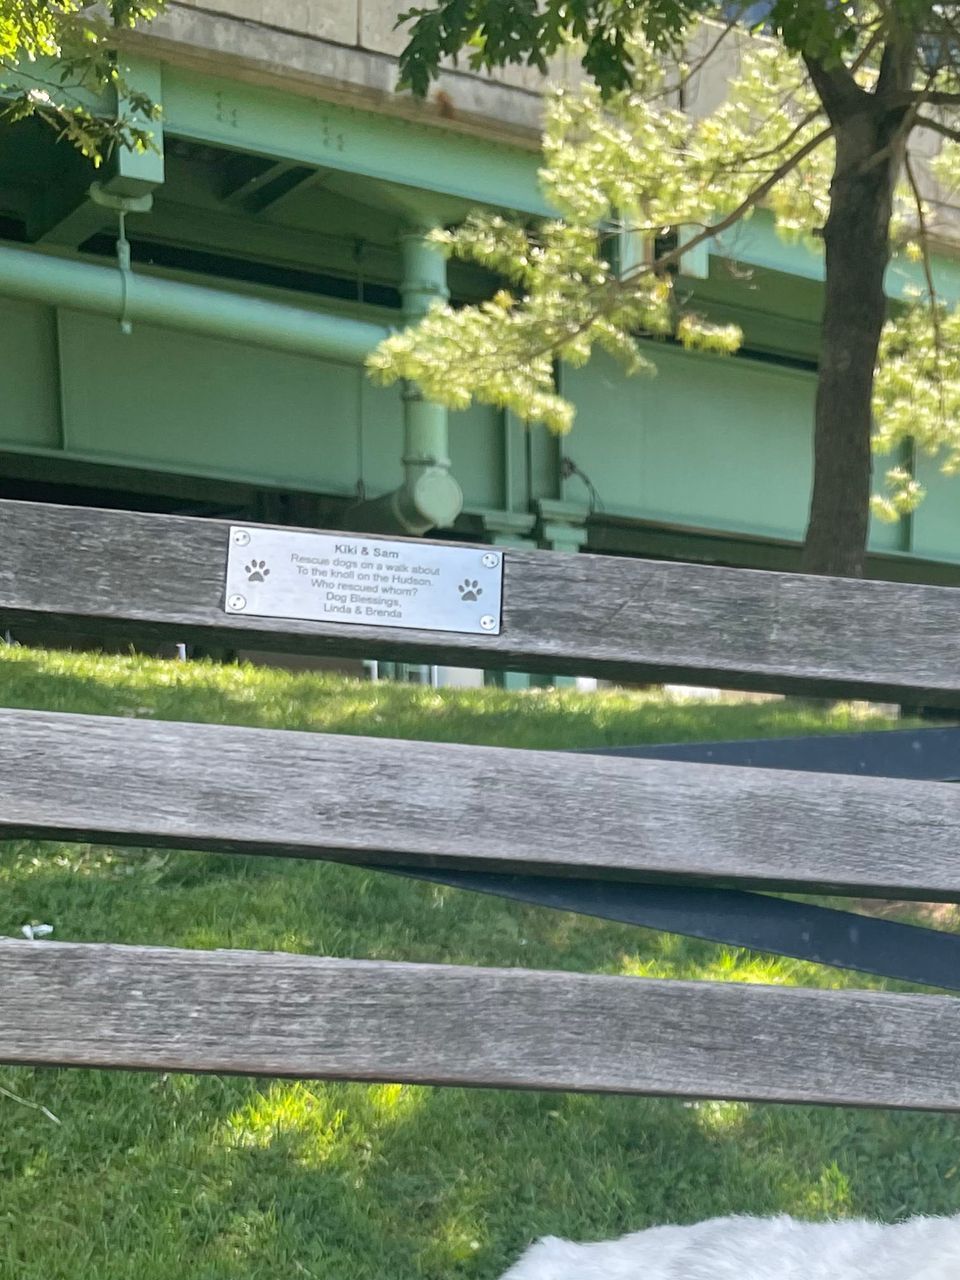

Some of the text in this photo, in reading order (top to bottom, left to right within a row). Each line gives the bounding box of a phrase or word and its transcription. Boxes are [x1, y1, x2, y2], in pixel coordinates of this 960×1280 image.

[335, 544, 399, 559] Kiki & Sam
[291, 554, 329, 566] Rescue
[333, 558, 357, 569] dogs
[361, 561, 373, 569] on
[386, 563, 408, 572] walk
[412, 566, 440, 575] about
[297, 566, 308, 575] To
[312, 567, 327, 577] the
[331, 569, 354, 579] knoll
[373, 573, 389, 582] the
[311, 579, 418, 596] Who rescued whom?
[326, 592, 402, 607] Dog Blessings,
[324, 604, 402, 618] Linda & Brenda
